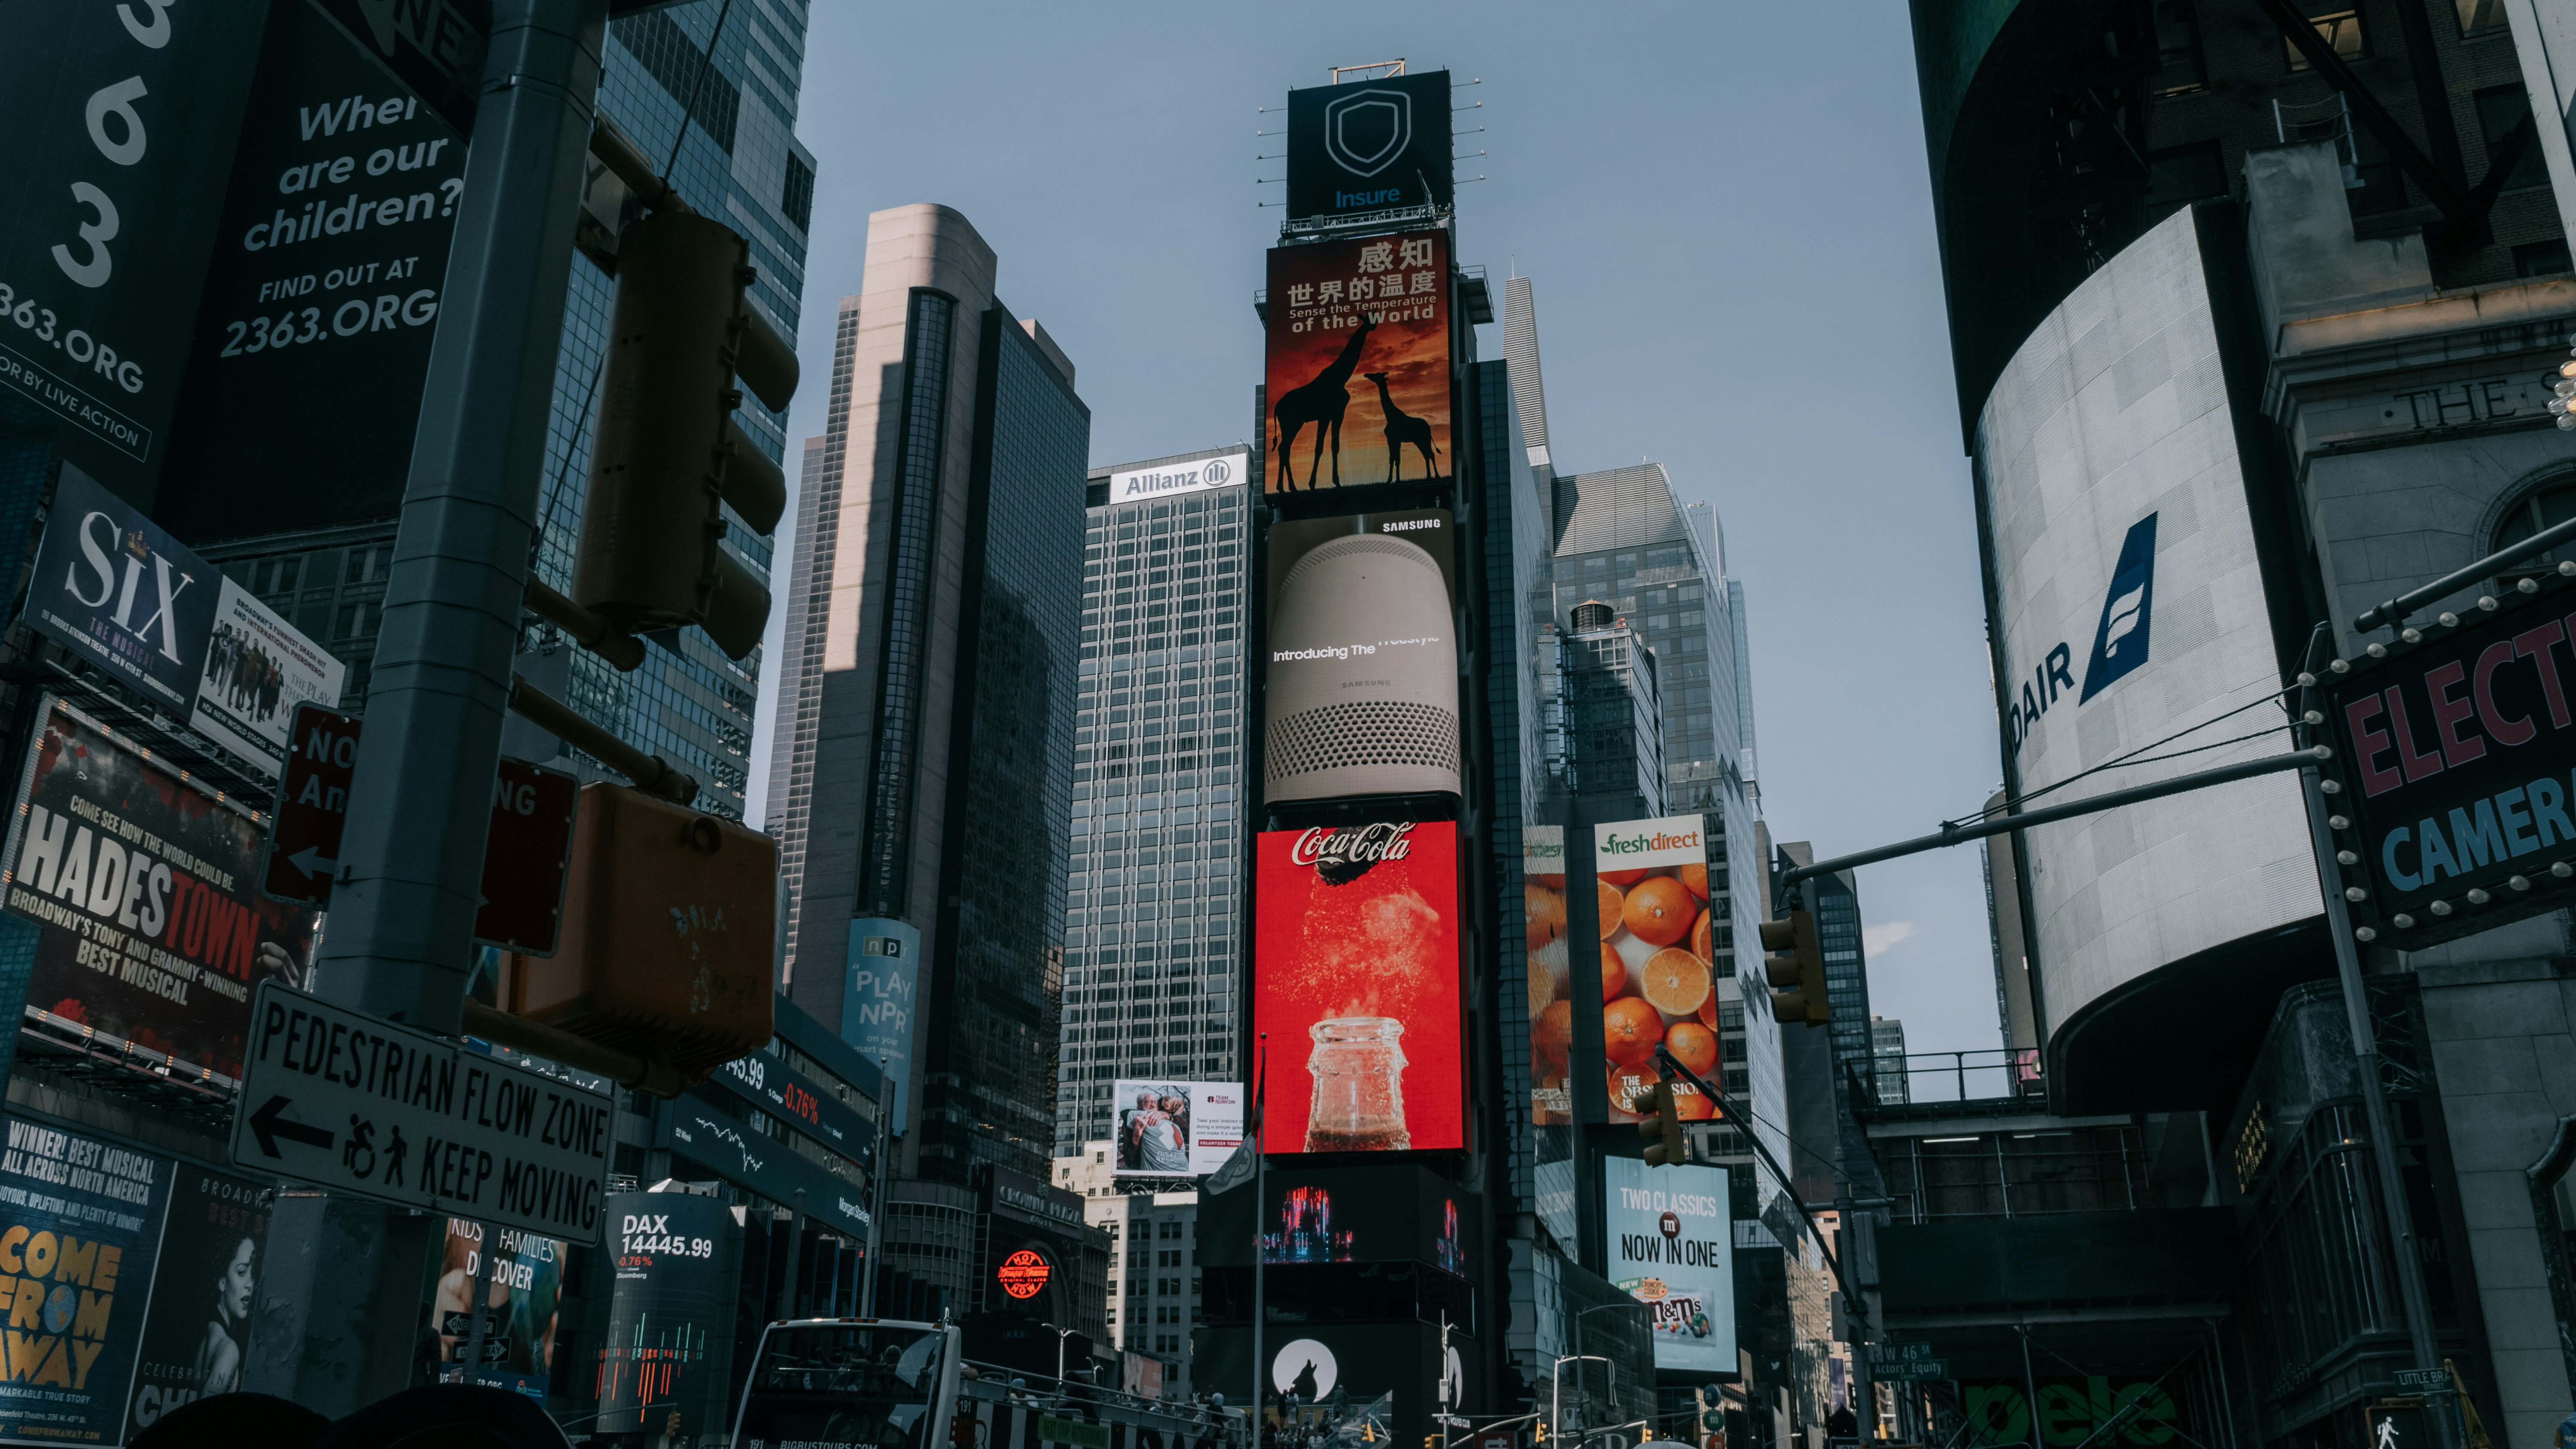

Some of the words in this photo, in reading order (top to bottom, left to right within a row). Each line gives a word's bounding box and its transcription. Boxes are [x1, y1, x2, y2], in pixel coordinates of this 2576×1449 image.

[279, 156, 355, 194] are
[366, 138, 448, 176] our
[243, 177, 464, 252] children?
[1336, 187, 1400, 209] Insure
[1358, 238, 1433, 274] 感知
[258, 274, 316, 303] FIND
[323, 262, 380, 291] OUT
[385, 257, 420, 281] AT
[1287, 270, 1437, 307] 世界的温度
[220, 288, 438, 358] 2363.ORG
[1289, 308, 1324, 319] Sense
[1330, 304, 1351, 315] the
[1354, 295, 1437, 312] Temperature
[1292, 317, 1314, 333] of
[1322, 314, 1358, 330] the
[1367, 303, 1434, 324] World
[24, 370, 45, 391] BY
[45, 383, 79, 412] LIVE
[79, 405, 139, 447] ACTION
[2394, 379, 2517, 429] THE
[1126, 471, 1198, 495] Allianz
[1382, 518, 1441, 532] SAMSUNG
[64, 511, 195, 666] SIX
[90, 616, 110, 641] THE
[112, 631, 155, 671] MUSICAL
[233, 608, 247, 621] AND
[247, 618, 290, 654] INTERNATIONAL
[290, 649, 325, 679] PHENOMENON
[236, 598, 273, 630] BROADWAY'S
[273, 625, 299, 648] FUNNIEST
[299, 644, 317, 661] SMASH
[316, 657, 326, 669] HIT
[1273, 644, 1348, 662] Introducing
[1351, 644, 1376, 655] The
[291, 673, 306, 691] THE
[306, 682, 332, 706] PLAY
[1342, 679, 1391, 688] SAMSUNG
[2345, 611, 2576, 798] ELECT
[213, 709, 228, 722] NEW
[228, 717, 247, 736] WORLD
[246, 731, 267, 749] STAGES
[305, 728, 358, 769] NO
[70, 794, 102, 824] COME
[100, 810, 120, 833] SEE
[118, 819, 144, 845] HOW
[143, 831, 163, 855] THE
[162, 840, 194, 871] WORLD
[193, 858, 223, 885] COULD
[222, 872, 235, 892] BE.
[1291, 822, 1416, 866] Coca-Cola
[1607, 831, 1699, 855] freshdirect
[2382, 767, 2576, 891] CAMER
[9, 887, 92, 937] BROADWAY'S
[125, 937, 150, 962] AND
[869, 940, 908, 958] npr
[76, 938, 122, 977] BEST
[120, 956, 189, 1006] MUSICAL
[881, 1036, 899, 1047] your
[260, 1001, 457, 1116] PEDESTRIAN
[462, 1067, 538, 1138] FLOW
[541, 1093, 608, 1159] ZONE
[1622, 1075, 1640, 1086] THE
[784, 1082, 819, 1125] -0.76%
[1623, 1098, 1632, 1109] IS
[8, 1120, 68, 1161] WINNER!
[67, 1138, 103, 1169] BEST
[101, 1146, 155, 1185] MUSICAL
[1, 1149, 23, 1174] ALL
[24, 1155, 70, 1185] ACROSS
[69, 1167, 105, 1194] NORTH
[104, 1176, 150, 1206] AMERICA
[419, 1137, 493, 1204] KEEP
[499, 1157, 598, 1231] MOVING
[29, 1192, 66, 1215] UPLIFTING
[65, 1201, 81, 1218] AND
[80, 1204, 107, 1223] PLENTY
[106, 1211, 117, 1225] OF
[207, 1202, 250, 1231] BEST
[1620, 1187, 1650, 1211] TWO
[1653, 1190, 1716, 1218] CLASSICS
[452, 1218, 483, 1242] KIDS
[623, 1215, 669, 1234] DAX
[0, 1225, 123, 1293] COME
[499, 1228, 555, 1263] FAMILIES
[622, 1235, 712, 1259] 14445.99
[1013, 1254, 1036, 1265] HOT
[1622, 1233, 1661, 1264] NOW
[1666, 1238, 1682, 1265] IN
[1686, 1240, 1719, 1268] ONE
[1011, 1283, 1036, 1295] NOW
[1619, 1279, 1638, 1289] NEW
[452, 1319, 468, 1330] ONE
[484, 1346, 501, 1357] WAY
[1885, 1346, 1896, 1361] W
[1902, 1345, 1917, 1360] 46
[1921, 1344, 1930, 1354] St
[1875, 1363, 1907, 1374] Actors'
[1911, 1362, 1942, 1375] Equity
[2398, 1372, 2430, 1385] LITTLE
[44, 1391, 65, 1402] TRUE
[65, 1393, 91, 1404] STORY
[2423, 1382, 2444, 1391] STREET
[960, 1399, 972, 1414] 191
[1044, 1419, 1056, 1439] NEXT
